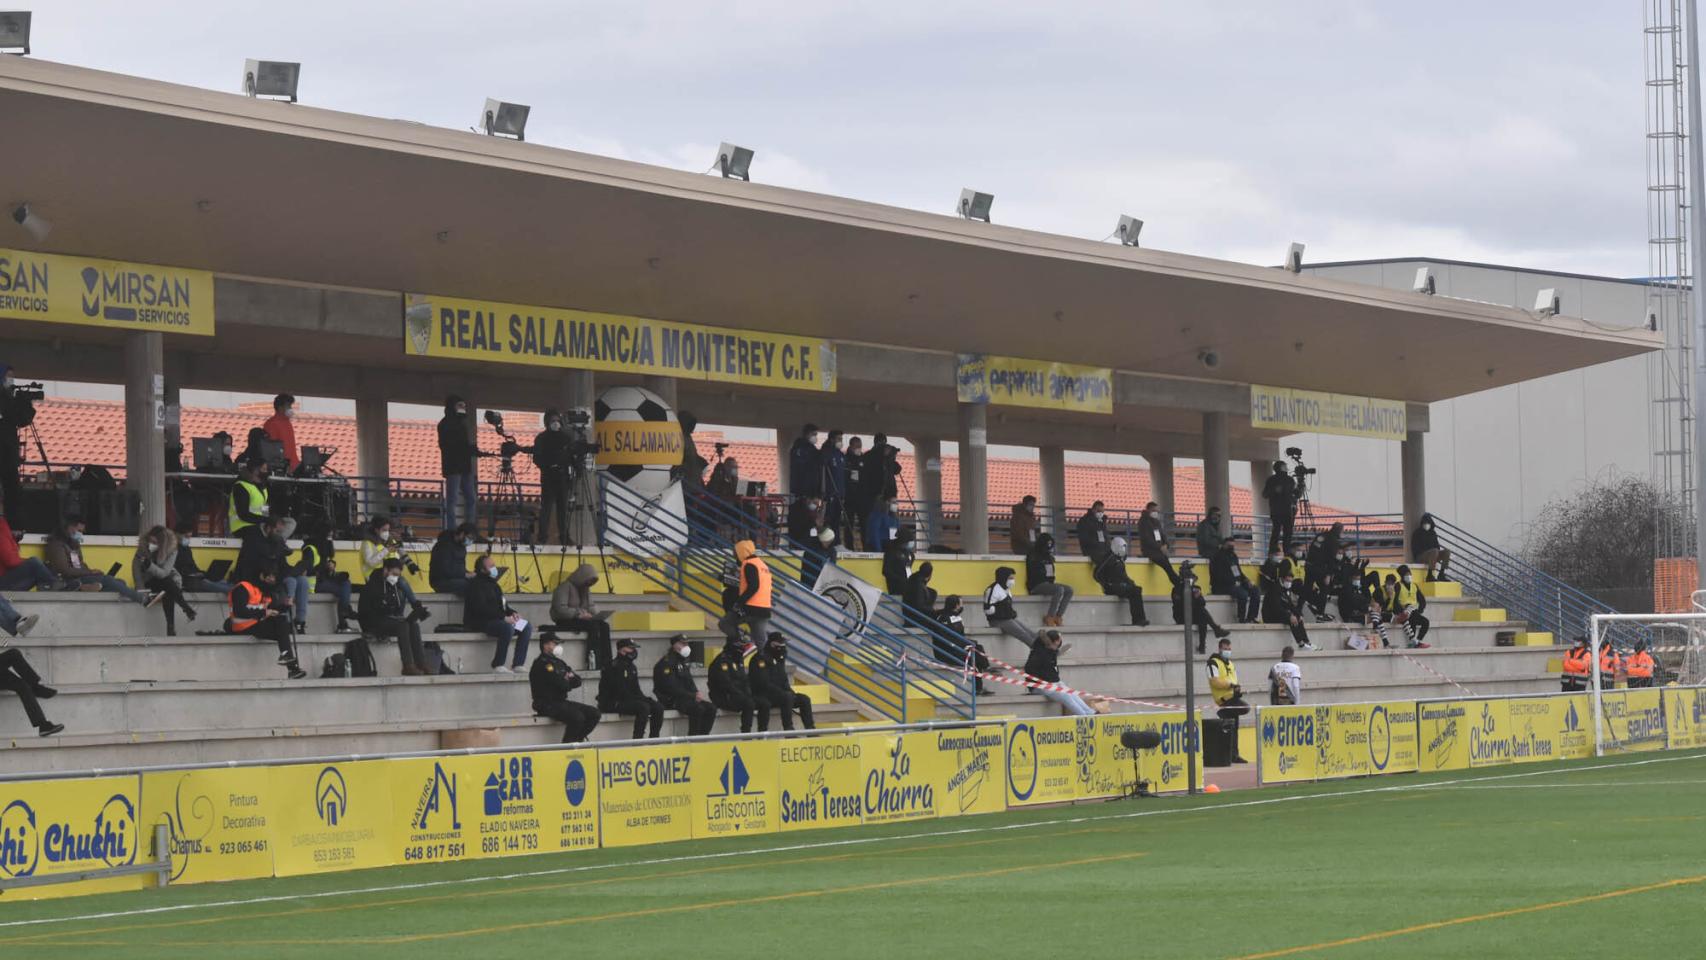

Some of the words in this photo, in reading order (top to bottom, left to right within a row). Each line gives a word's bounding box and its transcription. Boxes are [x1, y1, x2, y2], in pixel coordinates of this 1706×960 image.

[103, 271, 190, 308] MIRSAN
[138, 308, 190, 325] SERVICIOS
[440, 307, 502, 352] REAL
[661, 328, 775, 377] MONTEREY
[781, 343, 814, 381] C.F.
[1482, 703, 1495, 736] La
[1510, 703, 1550, 715] ELECTRICIDAD
[1277, 715, 1314, 747] errea
[1344, 730, 1368, 745] Granitos
[781, 744, 861, 763] ELECTRICIDAD
[1470, 726, 1511, 760] Charra
[1512, 735, 1530, 758] Santa
[1531, 733, 1552, 755] Teresa
[499, 756, 533, 779] JOR
[890, 736, 910, 781] La
[635, 756, 691, 787] GOMEZ
[229, 793, 258, 807] Pintura
[500, 778, 533, 801] CAR
[865, 768, 933, 815] Charra
[411, 776, 434, 830] NAVEIRA
[503, 803, 533, 816] reformas
[707, 797, 766, 820] Lafisconta
[782, 789, 817, 824] Santa
[821, 786, 861, 820] Teresa
[223, 813, 266, 830] Decorativa
[480, 820, 508, 833] ELADIO
[509, 818, 540, 832] NAVEIRA
[44, 818, 127, 862] Chuchi
[219, 842, 235, 855] 923
[237, 841, 252, 853] 065
[253, 839, 268, 852] 461
[410, 831, 461, 842] CONSTRUCCIONES
[482, 836, 499, 853] 686
[502, 835, 519, 851] 144
[521, 833, 538, 849] 793
[404, 847, 423, 861] 648
[427, 845, 444, 859] 817
[447, 842, 465, 857] 561
